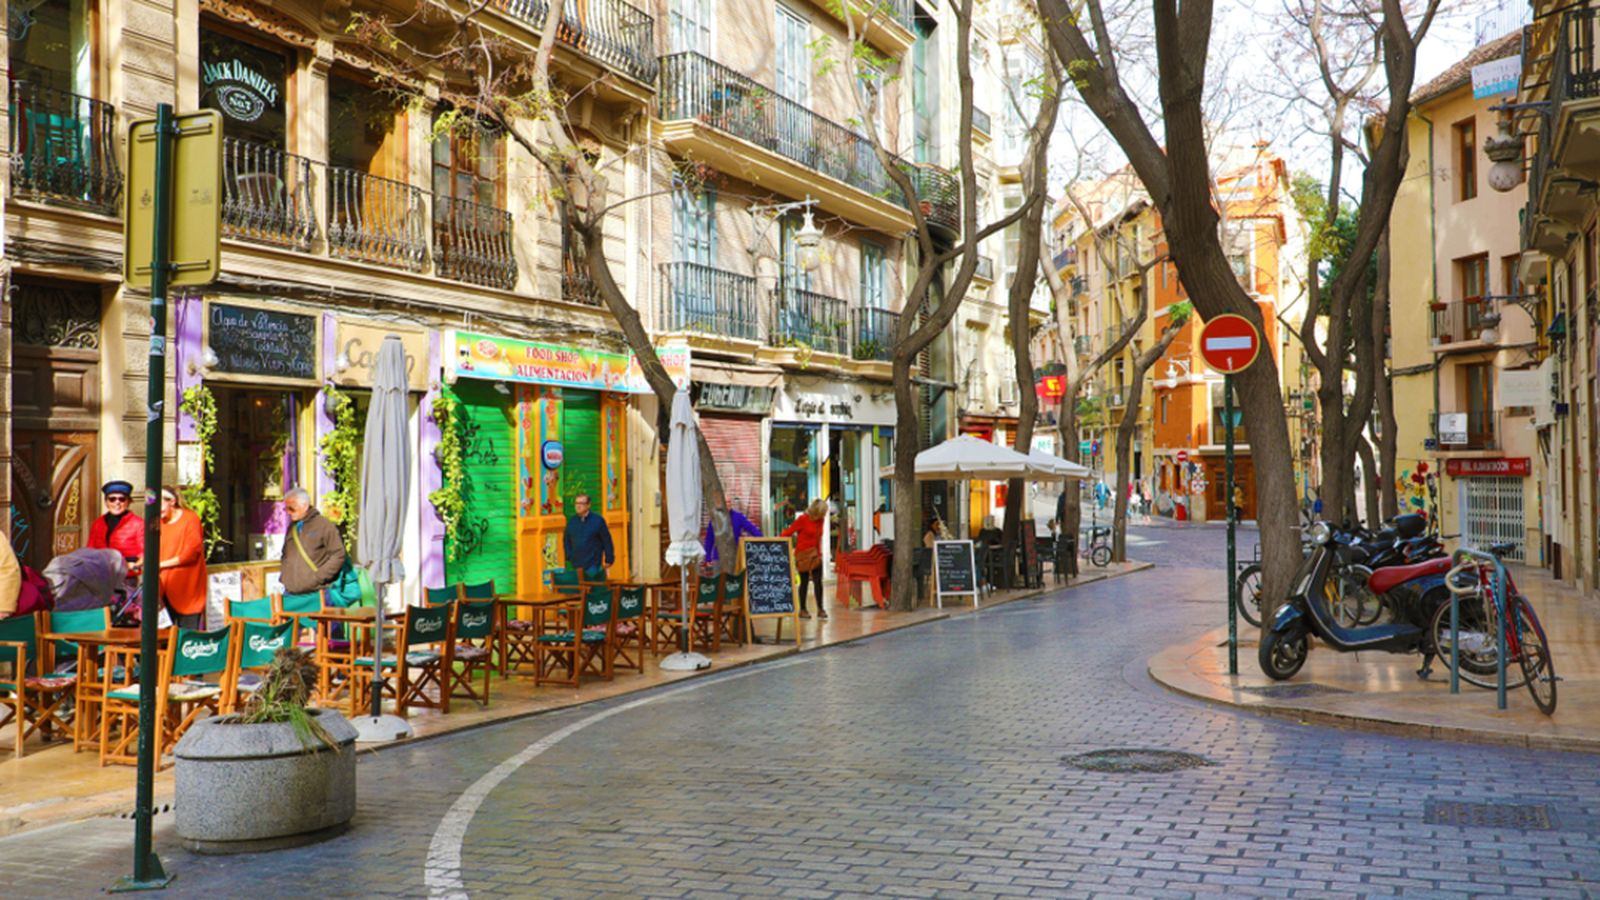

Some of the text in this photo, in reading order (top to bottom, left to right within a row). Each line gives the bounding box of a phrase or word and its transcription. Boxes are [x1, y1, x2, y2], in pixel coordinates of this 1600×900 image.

[202, 59, 279, 107] JACK DANIEL'S
[526, 346, 580, 365] FOOD SHOP
[181, 638, 219, 659] Carlsberg
[248, 633, 285, 652] Carlsberg
